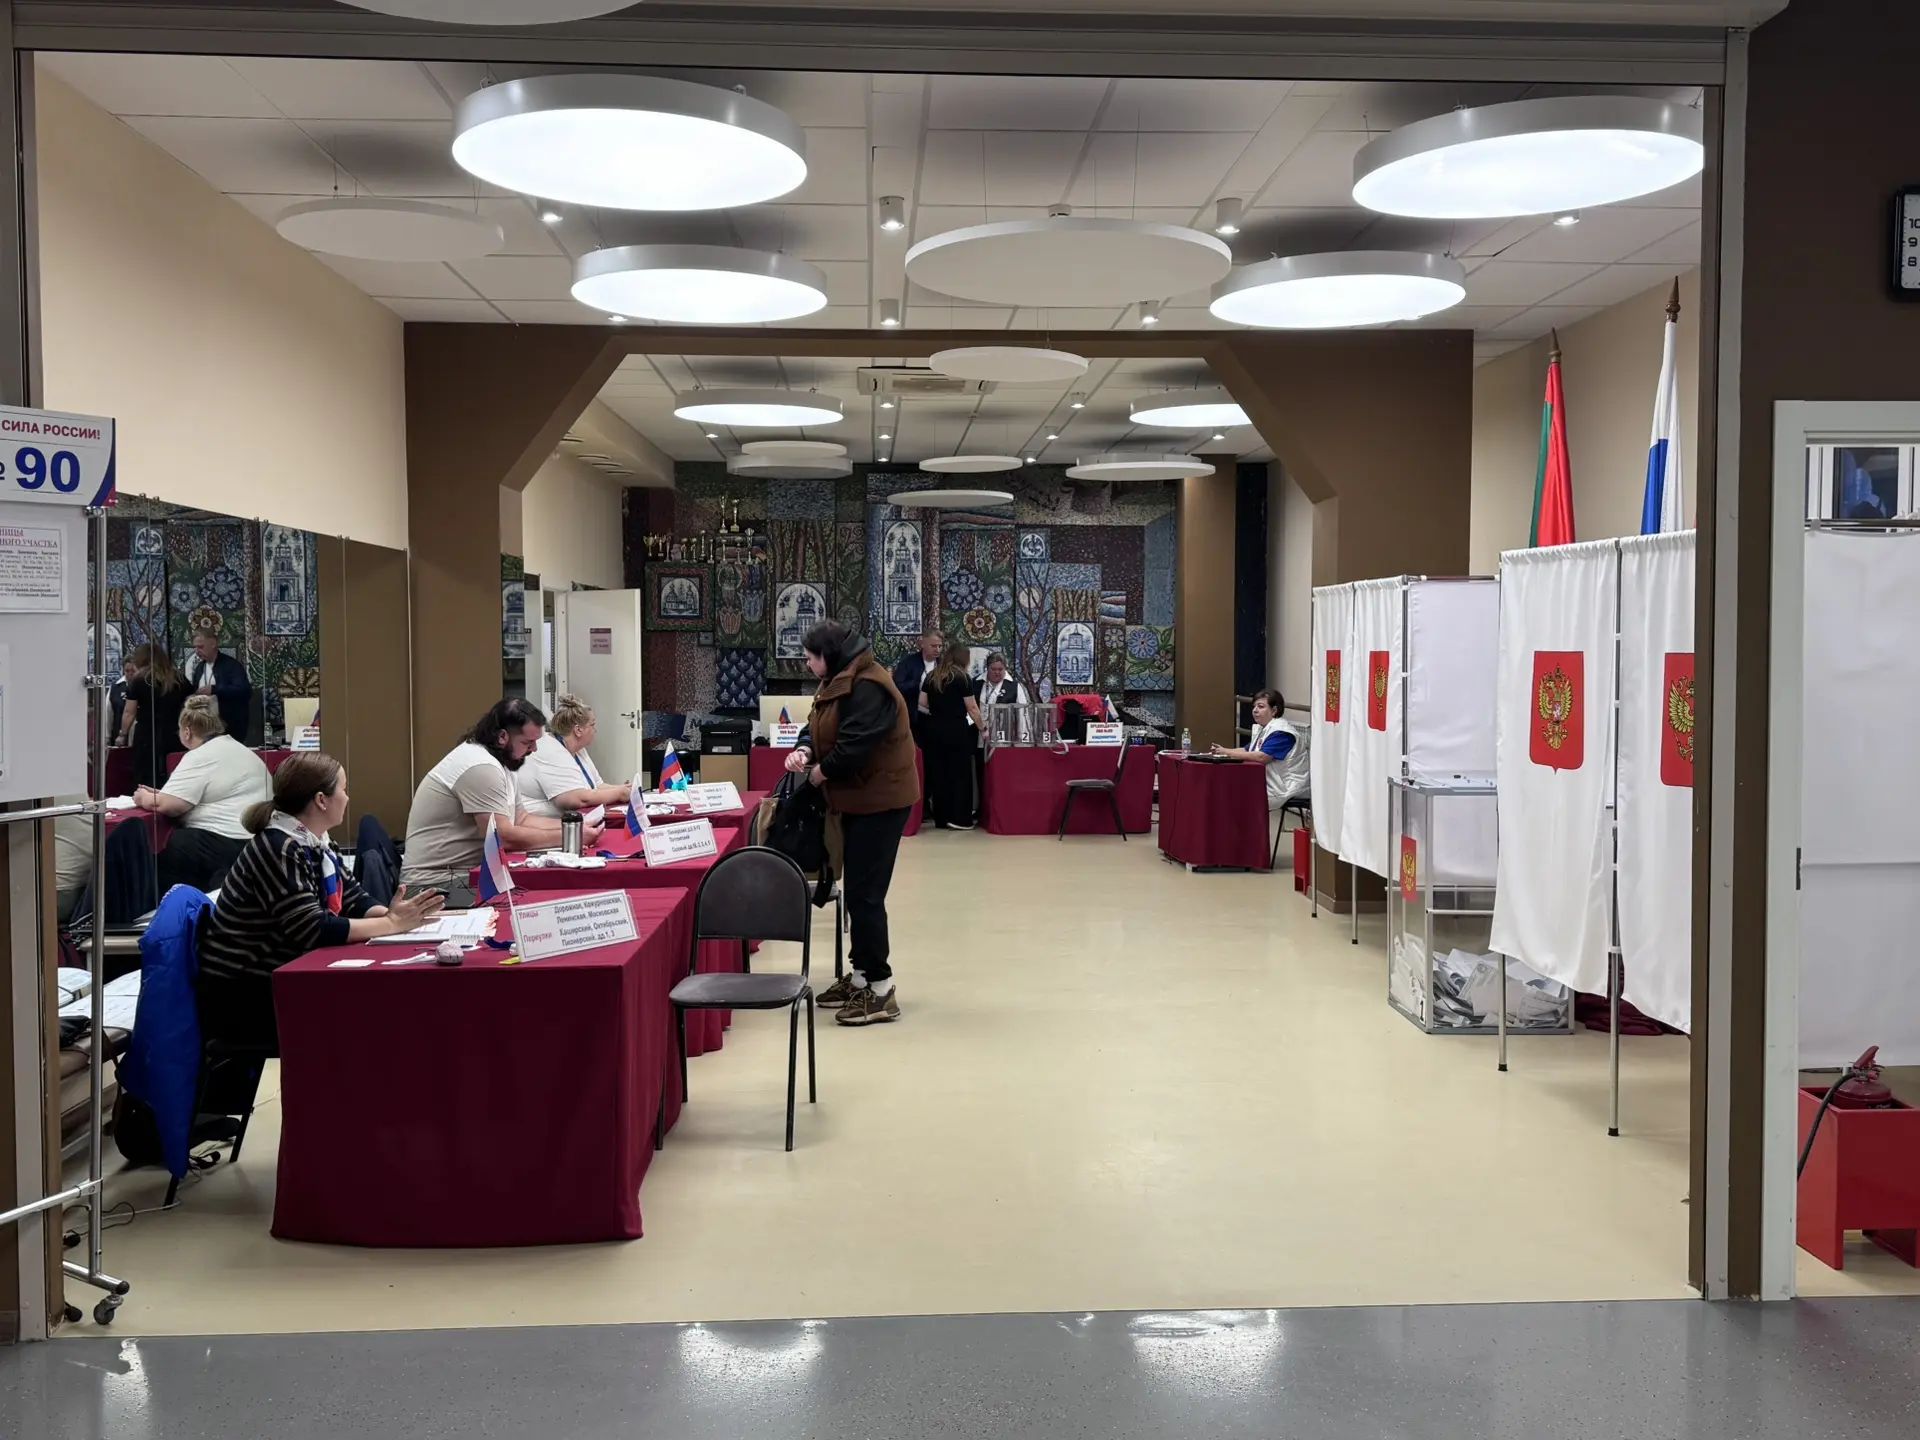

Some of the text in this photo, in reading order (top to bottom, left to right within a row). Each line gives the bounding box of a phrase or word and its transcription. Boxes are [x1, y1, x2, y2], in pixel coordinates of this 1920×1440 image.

[1908, 237, 1918, 247] 9
[1907, 256, 1917, 267] 8
[2, 420, 101, 440] СИЛА РОССИИ!
[15, 447, 80, 493] 90
[518, 911, 539, 921] Улицы
